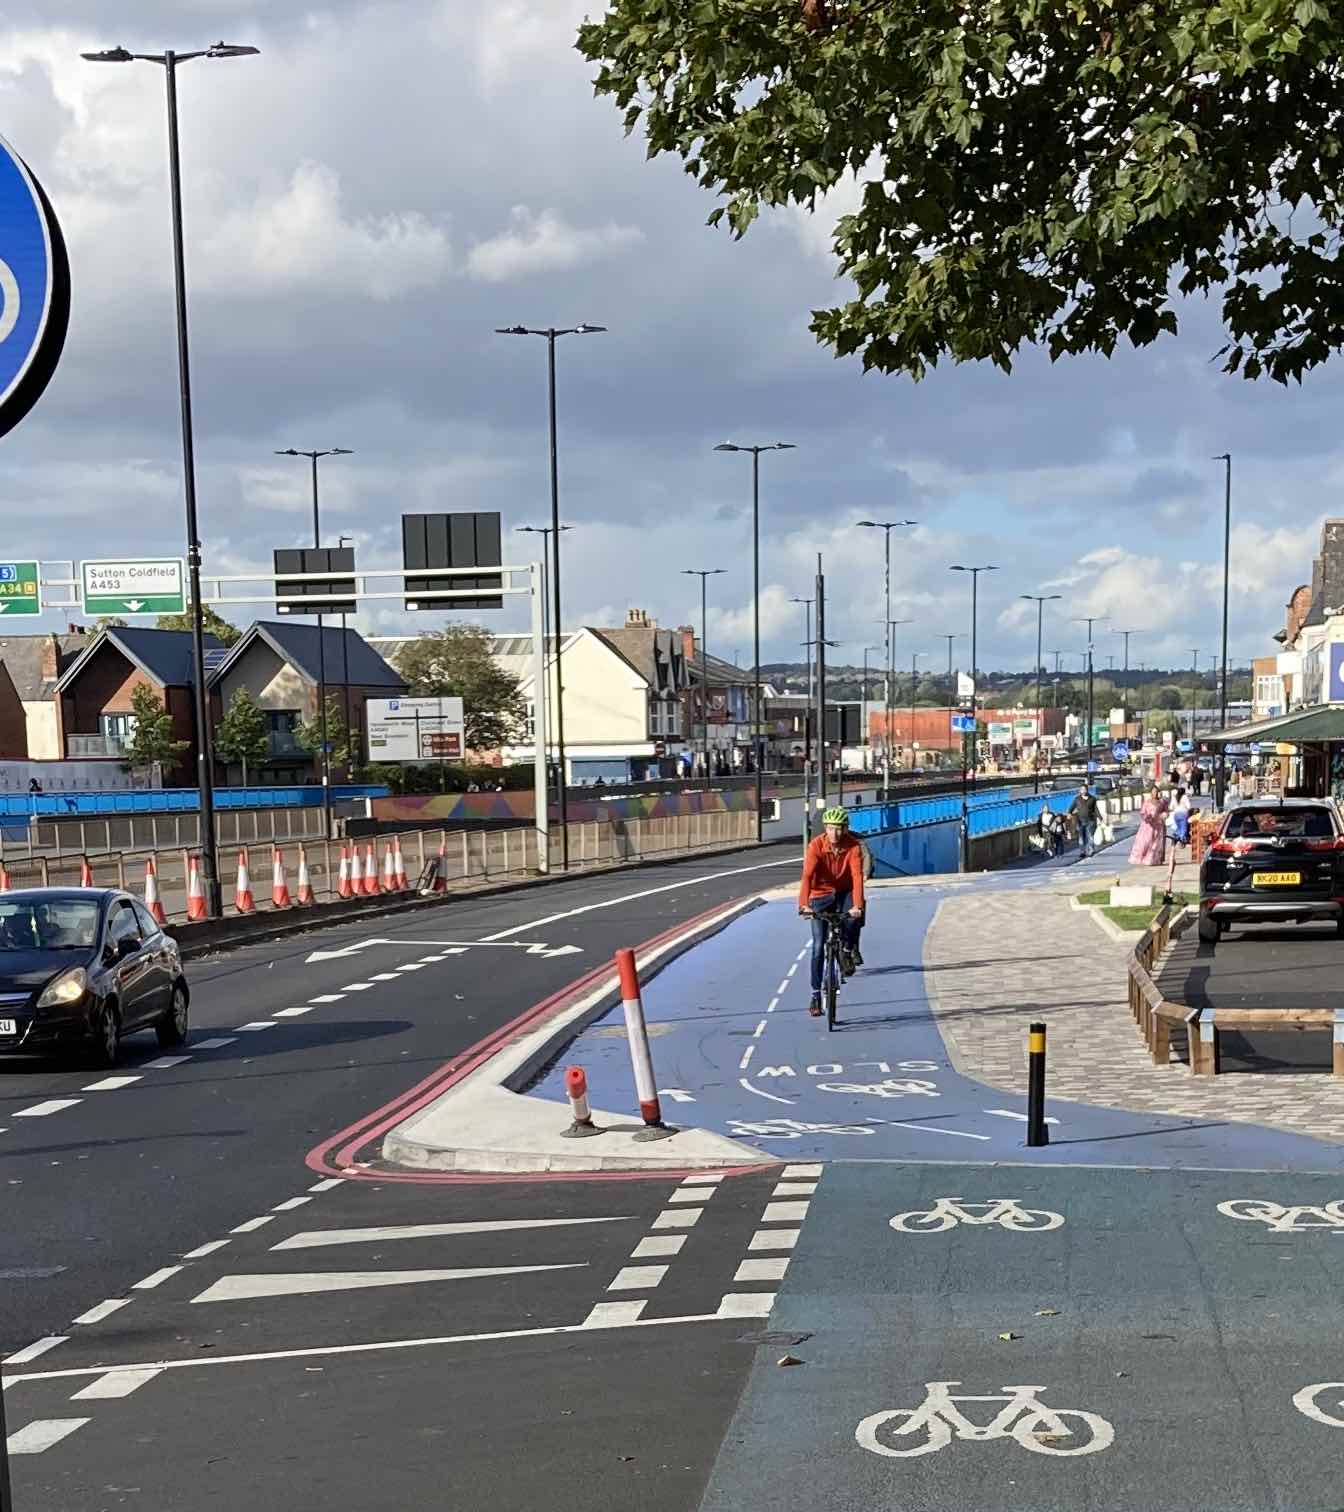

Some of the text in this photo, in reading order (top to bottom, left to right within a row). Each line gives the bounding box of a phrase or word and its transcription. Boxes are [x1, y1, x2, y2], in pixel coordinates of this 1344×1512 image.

[90, 567, 176, 578] Sutton Coldfield
[0, 583, 22, 595] A34
[90, 579, 121, 590] A453
[756, 1060, 940, 1078] SLOW
